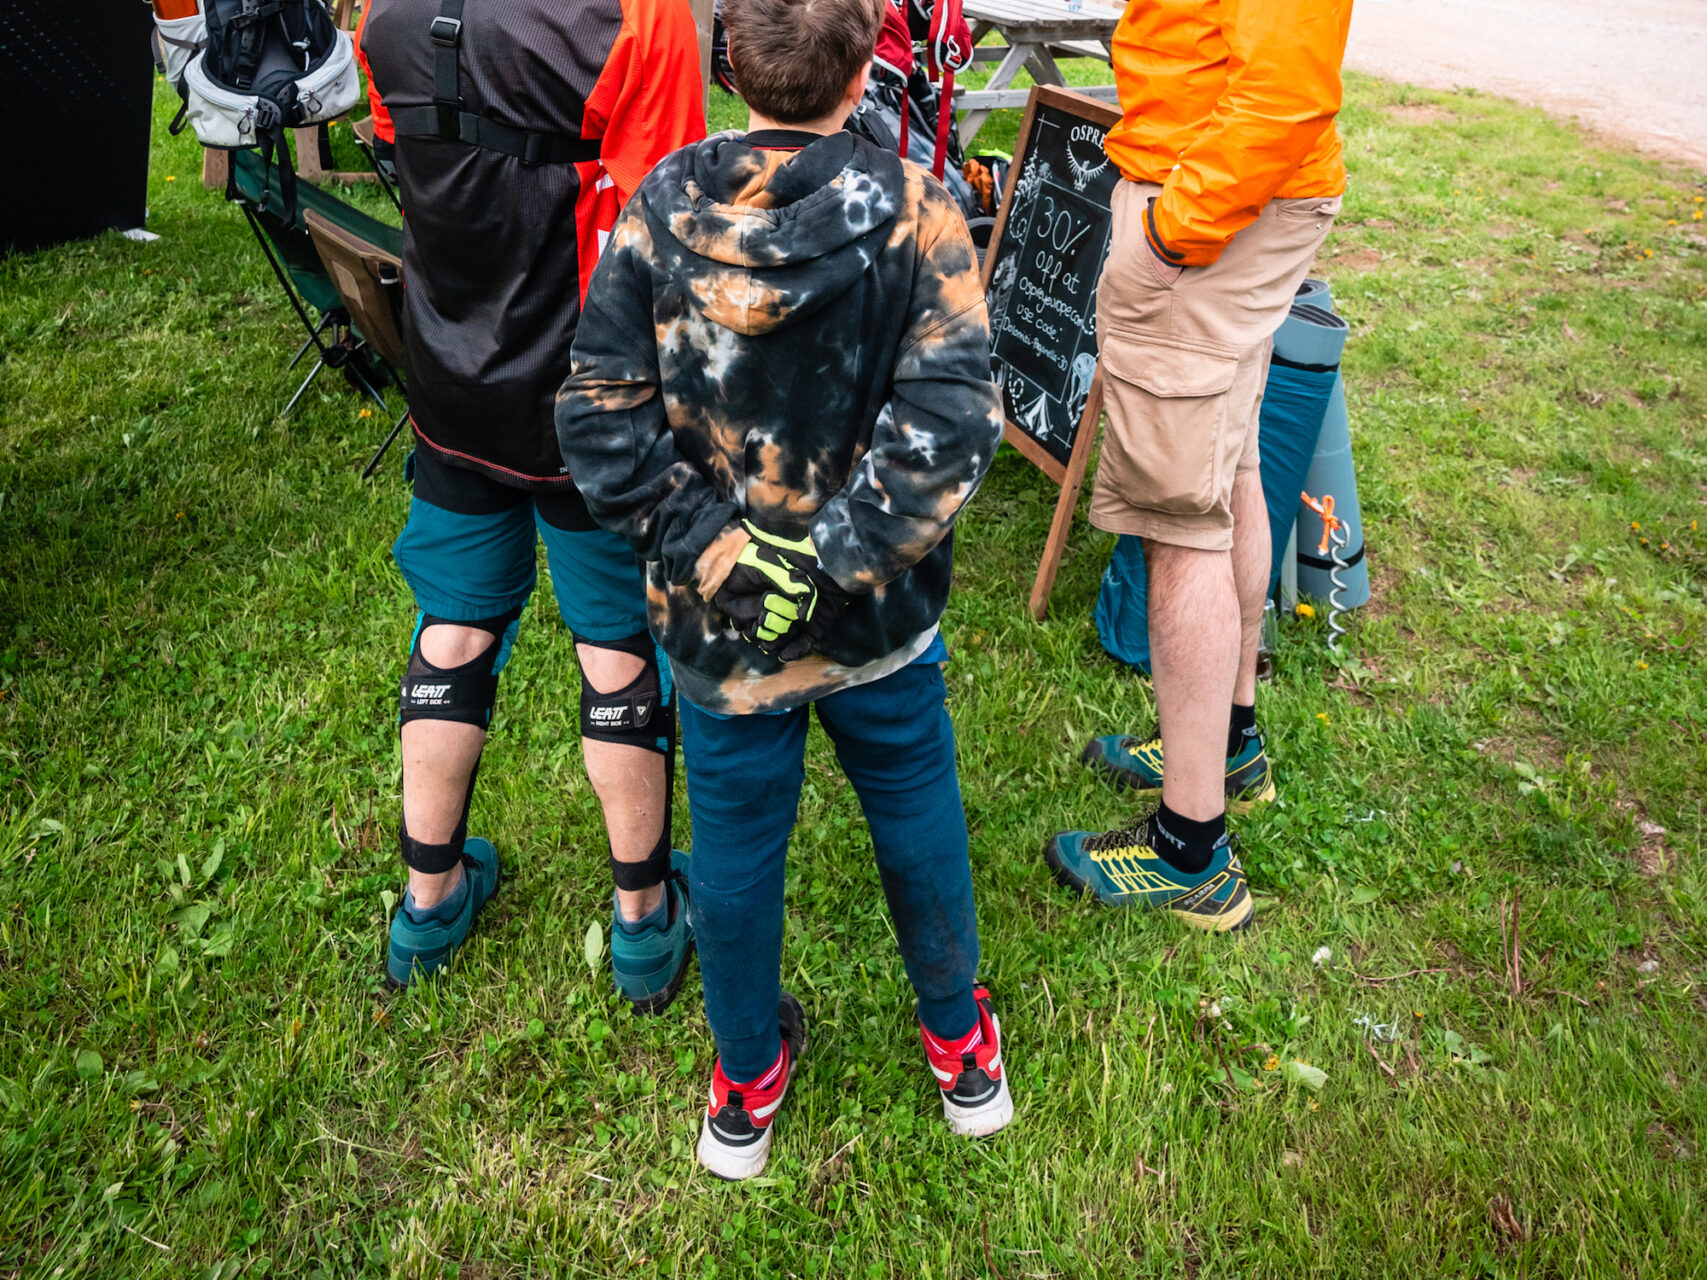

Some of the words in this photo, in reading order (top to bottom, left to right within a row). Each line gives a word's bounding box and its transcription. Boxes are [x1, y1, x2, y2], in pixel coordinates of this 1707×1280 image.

[1070, 124, 1107, 151] OSPRE
[1036, 195, 1091, 256] 30%
[1062, 272, 1080, 295] at
[411, 684, 452, 699] LEATT
[590, 705, 629, 720] LEATT
[1183, 882, 1216, 907] SCARPA
